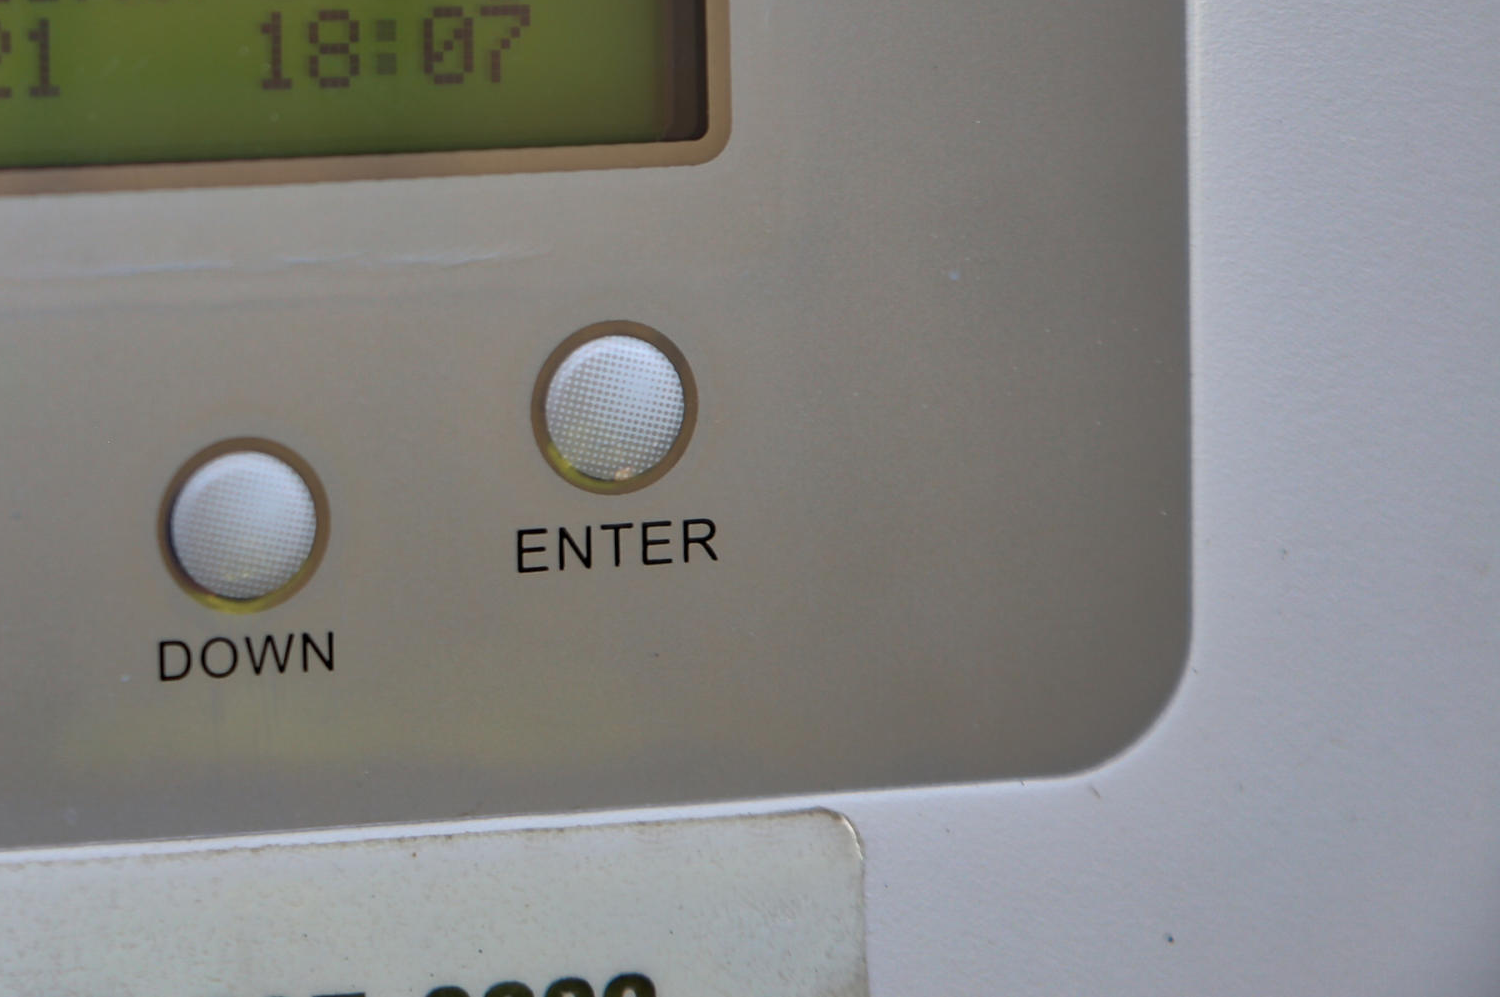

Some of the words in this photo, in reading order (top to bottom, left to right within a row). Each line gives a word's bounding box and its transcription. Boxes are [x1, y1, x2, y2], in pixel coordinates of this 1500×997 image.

[259, 4, 531, 91] 18:07
[515, 518, 719, 573] ENTER
[158, 631, 336, 681] DOWN
